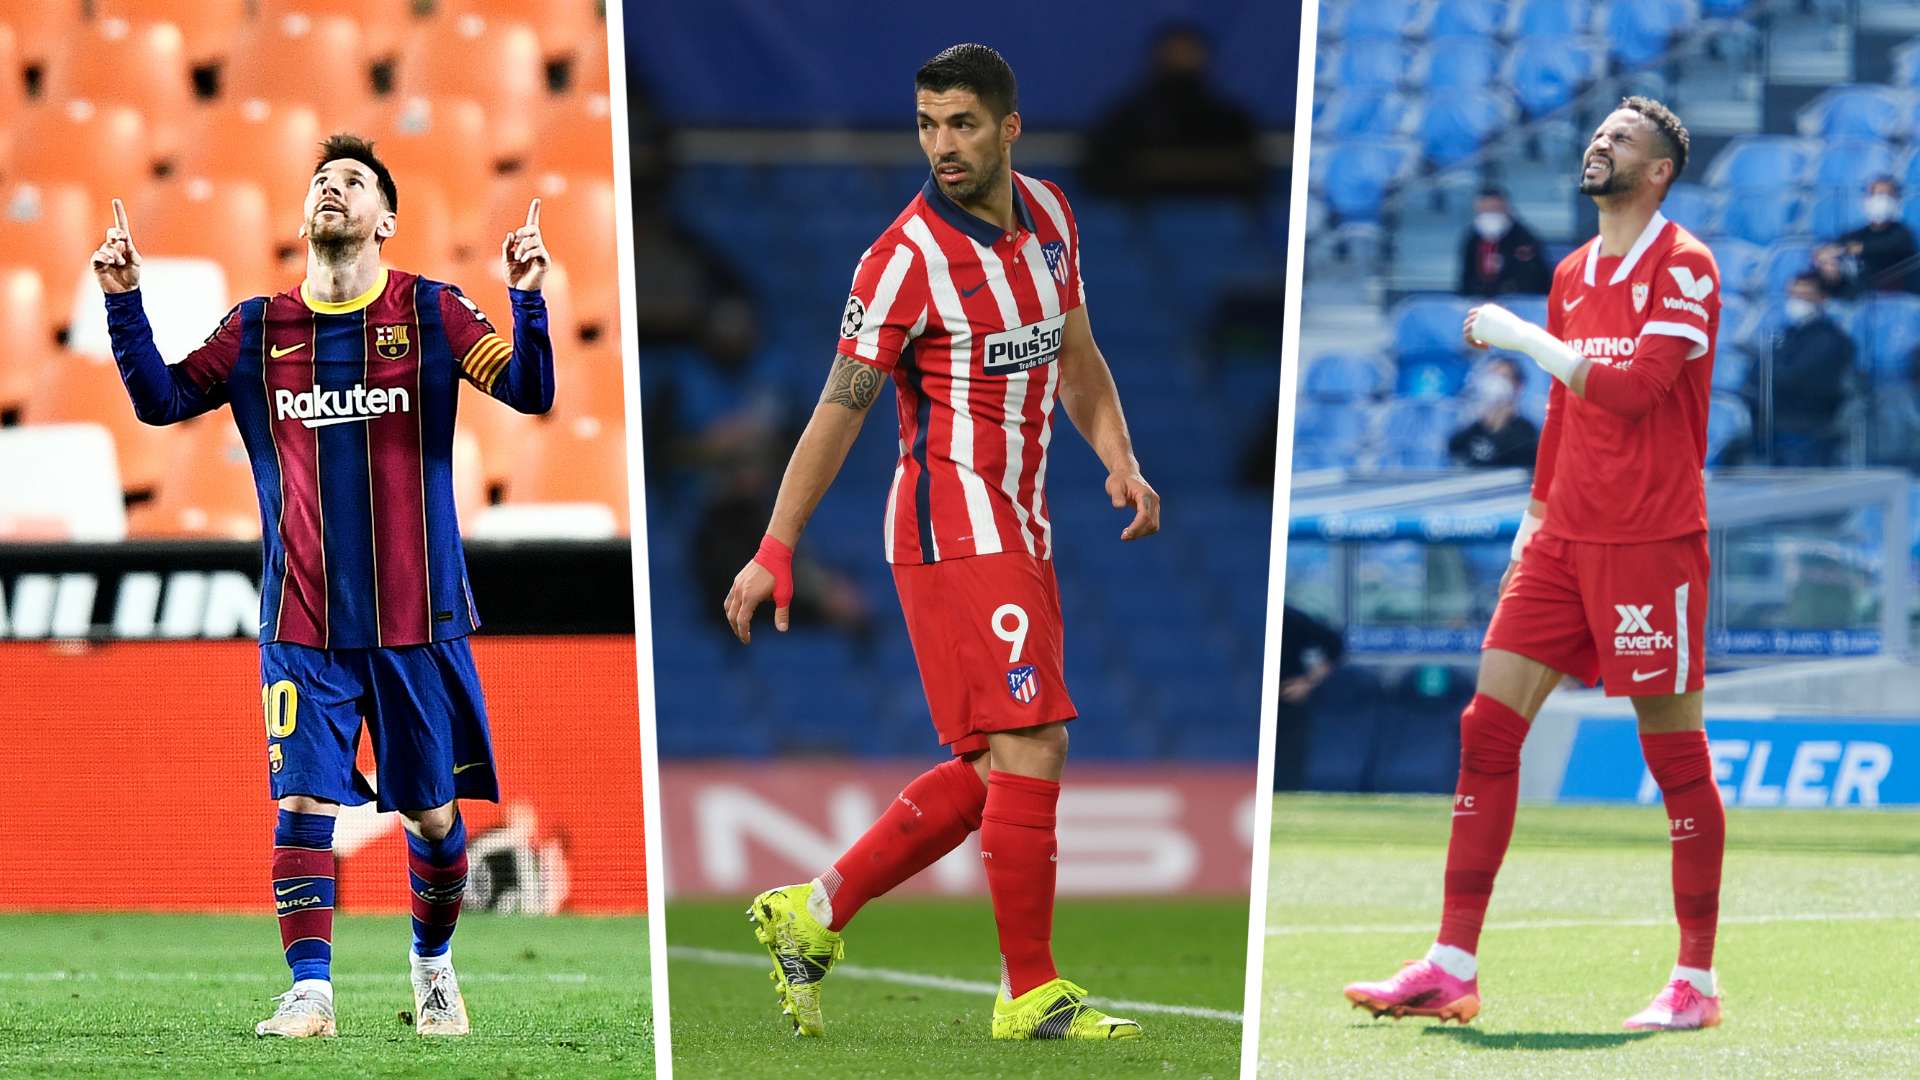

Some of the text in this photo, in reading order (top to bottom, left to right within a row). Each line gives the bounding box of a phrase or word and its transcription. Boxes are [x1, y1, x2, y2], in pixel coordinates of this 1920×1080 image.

[988, 327, 1064, 364] Plus50
[1566, 335, 1640, 357] RATHO
[1018, 359, 1037, 370] Trade
[275, 383, 410, 422] Rakuten
[991, 603, 1029, 664] 9
[1614, 631, 1673, 650] everfx
[1637, 740, 1893, 808] ELER
